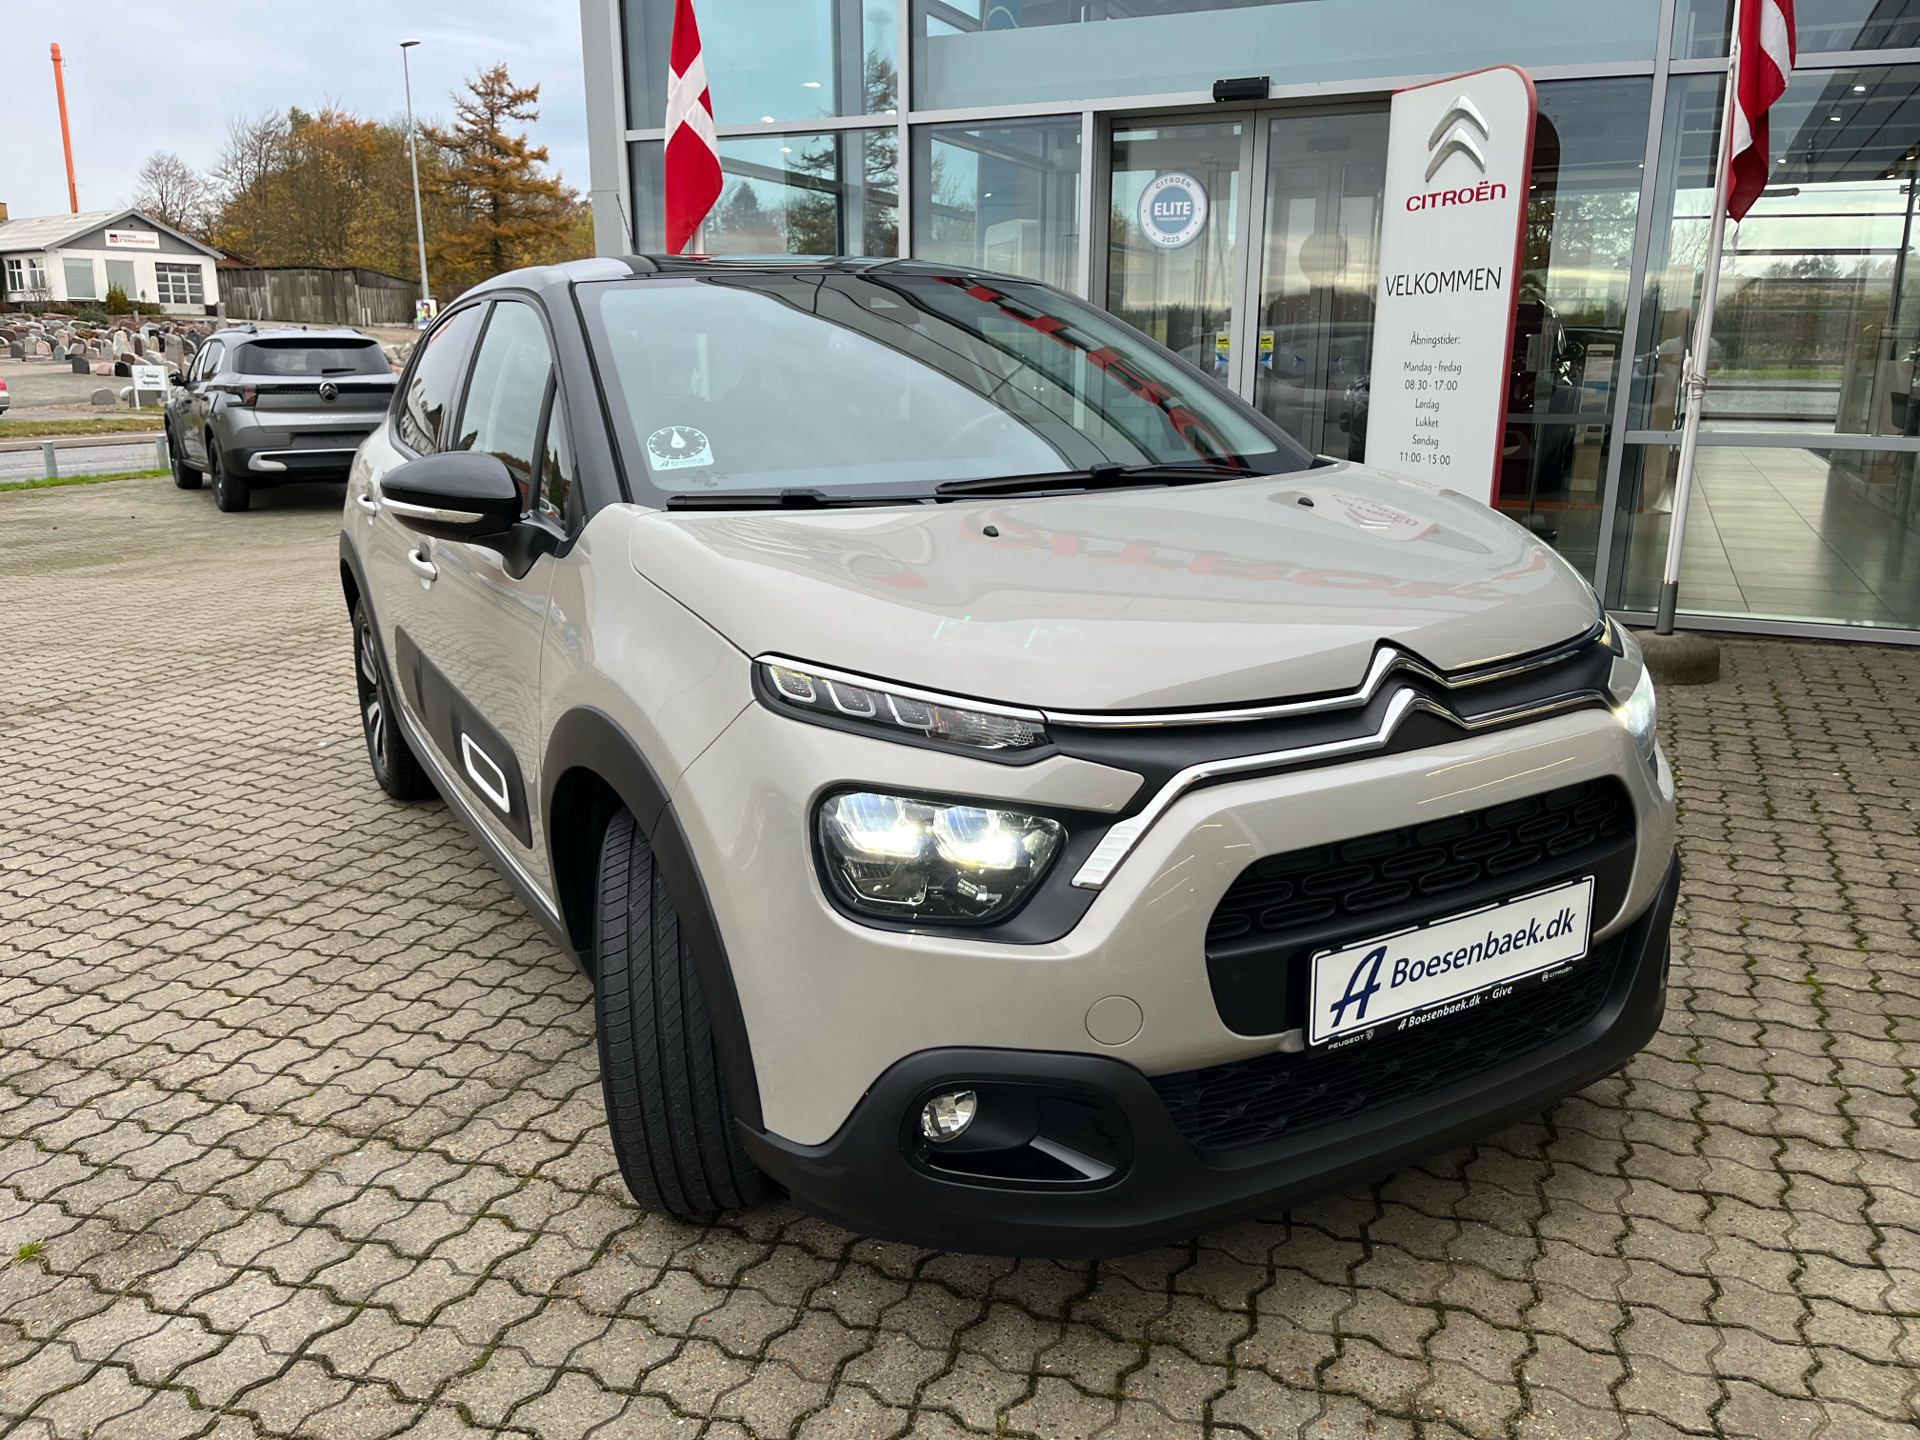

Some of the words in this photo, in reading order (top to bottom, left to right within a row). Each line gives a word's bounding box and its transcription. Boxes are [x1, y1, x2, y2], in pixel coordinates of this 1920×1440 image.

[1155, 177, 1191, 190] CITROËN
[1406, 180, 1507, 212] CITROËN
[1154, 202, 1191, 216] ELITE
[1162, 235, 1180, 243] 2023
[1385, 266, 1502, 297] VELKOMMEN
[1410, 331, 1461, 348] Åbningstider:
[1403, 361, 1432, 376] Mandag
[1438, 360, 1462, 376] fredag
[1404, 379, 1428, 391] 08:30
[1434, 379, 1458, 391] 17:00
[1415, 398, 1440, 413] Lørdag
[1415, 416, 1439, 428] Lukket
[1411, 433, 1439, 450] Søndag
[1399, 451, 1421, 463] 11:00
[1427, 453, 1451, 465] 15:00
[1389, 907, 1576, 989] Boesenbaek.dk
[1408, 995, 1481, 1028] Boesenbaek.dk
[1492, 985, 1513, 999] Give
[1328, 1034, 1365, 1051] PEUGEOT
